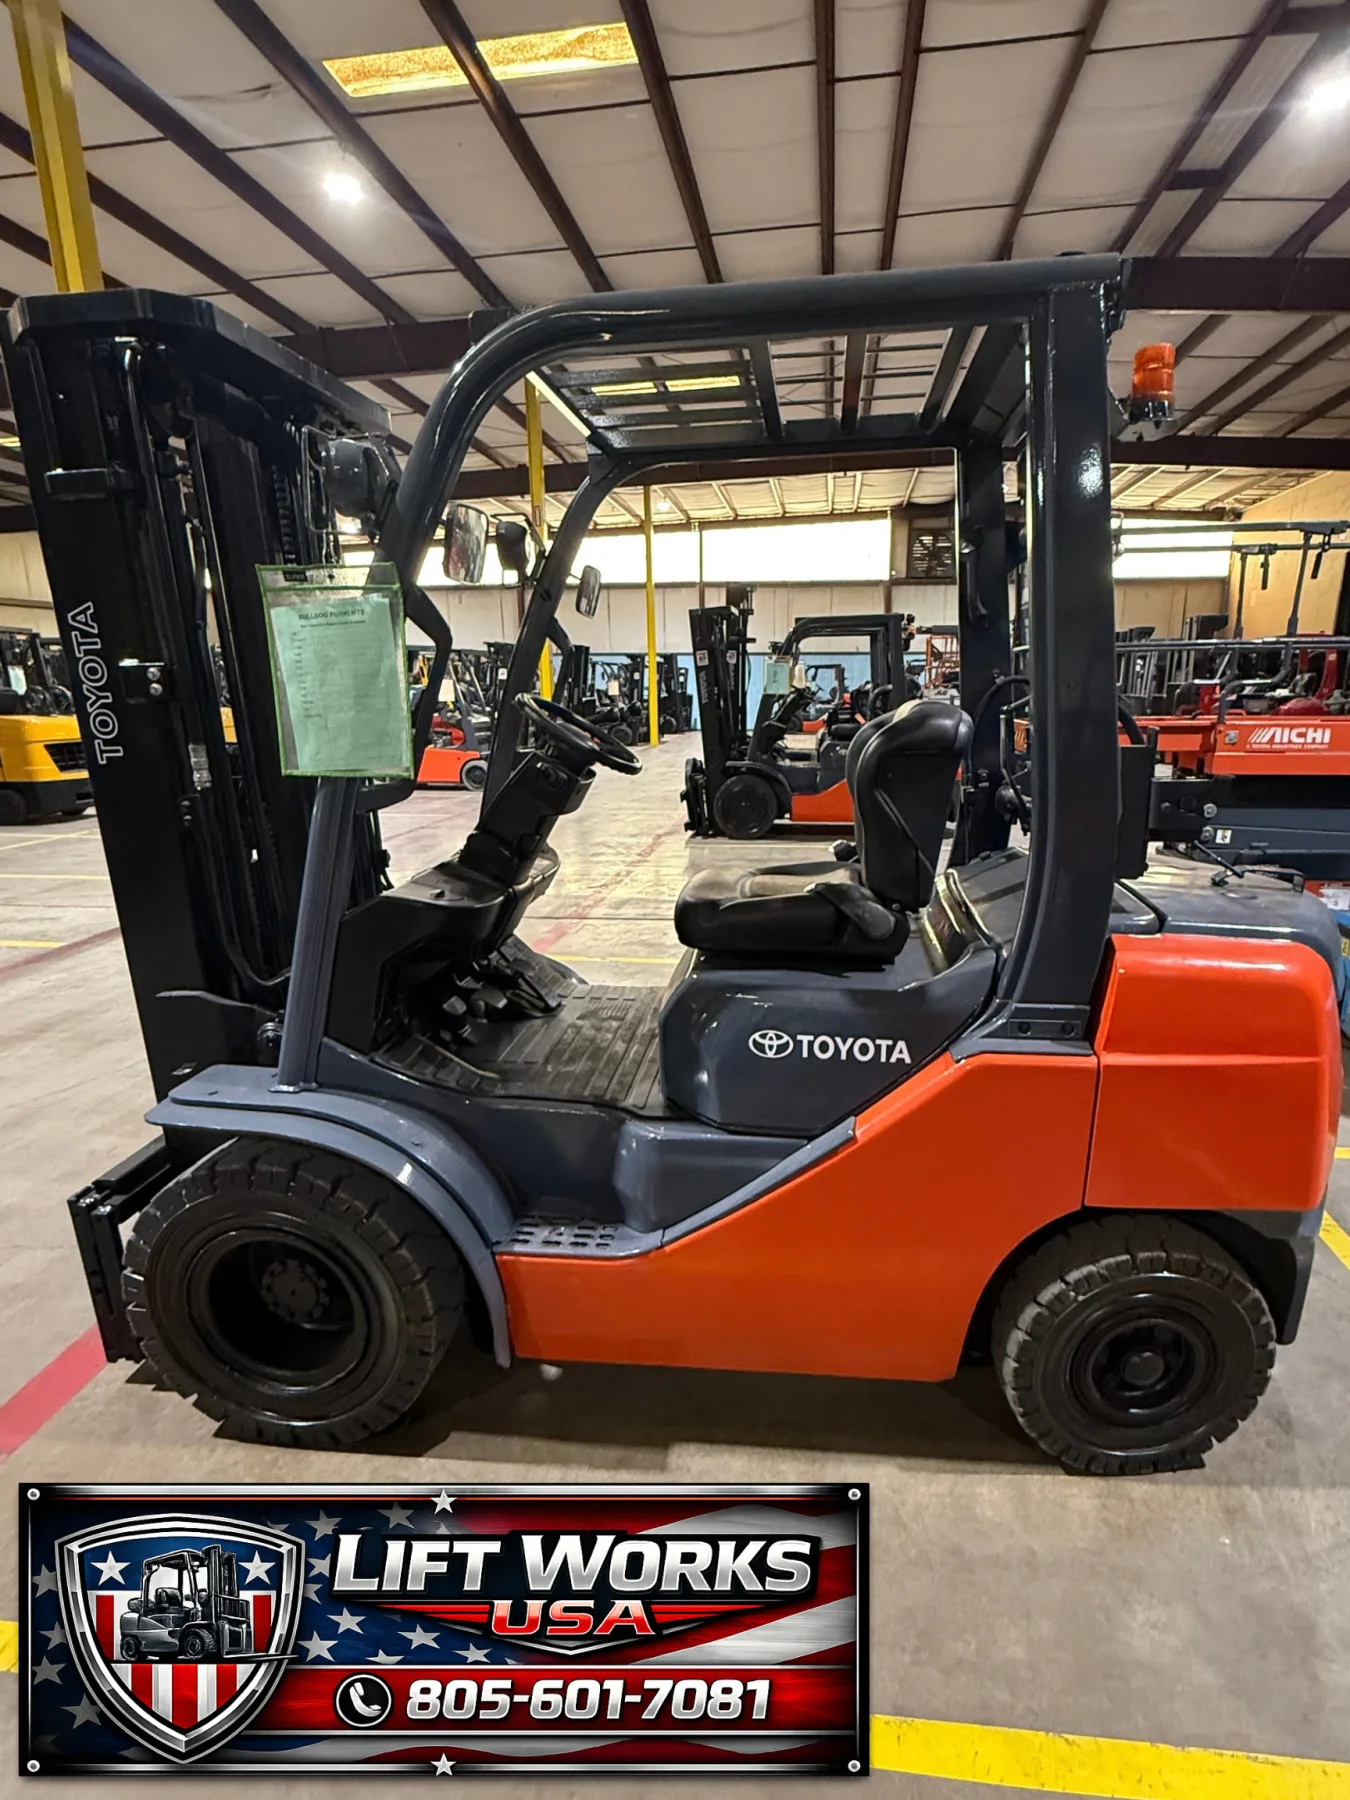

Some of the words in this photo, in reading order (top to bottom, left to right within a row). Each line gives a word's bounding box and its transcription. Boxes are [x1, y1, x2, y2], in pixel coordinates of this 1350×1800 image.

[67, 600, 125, 765] TOYOTA
[1247, 726, 1331, 744] AICHI
[796, 1034, 912, 1064] TOYOTA
